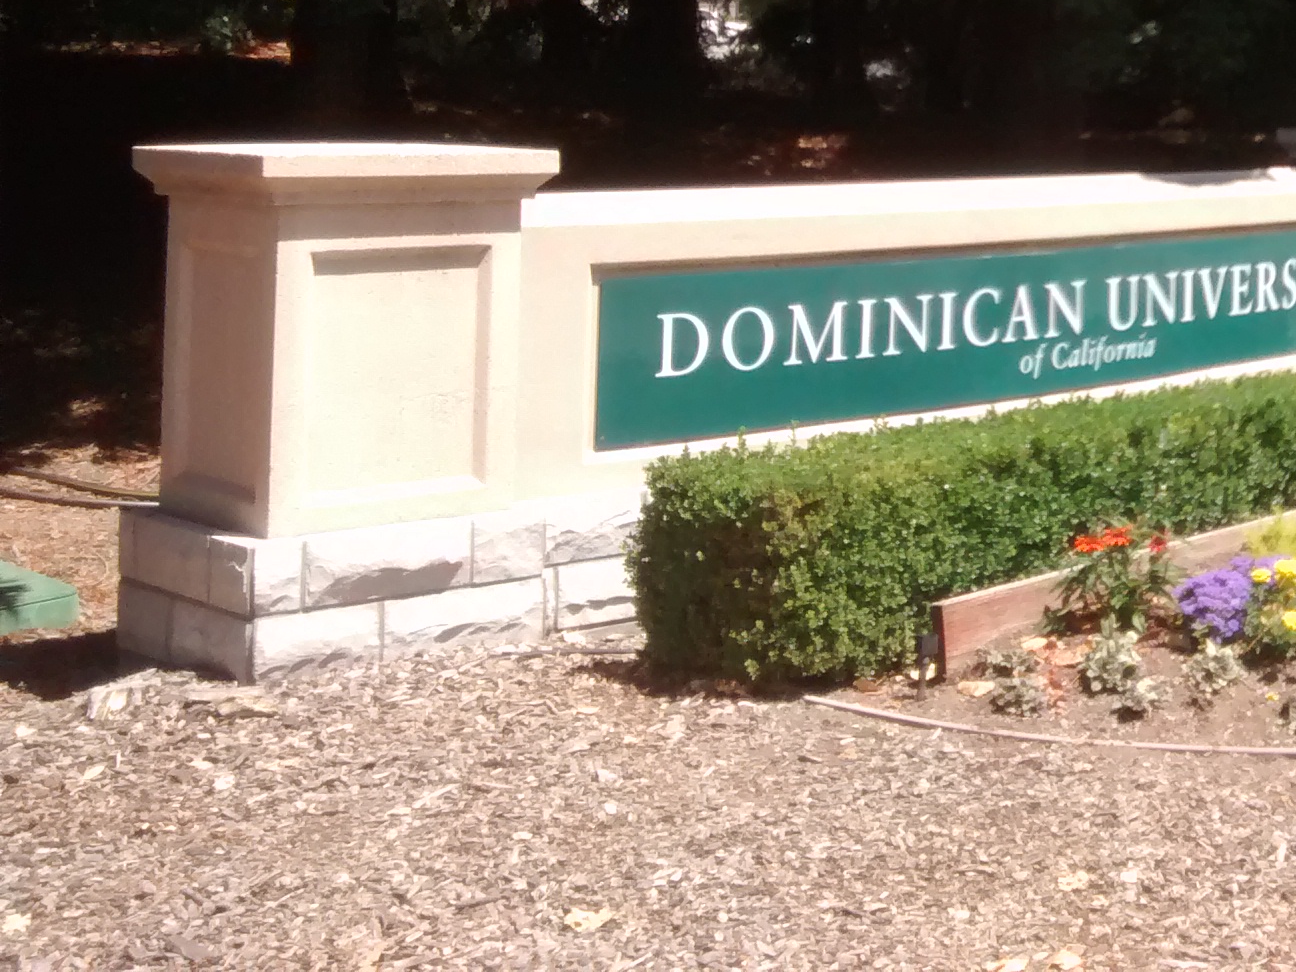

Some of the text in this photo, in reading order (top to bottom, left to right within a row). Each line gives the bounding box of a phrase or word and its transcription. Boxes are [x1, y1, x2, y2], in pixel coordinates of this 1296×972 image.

[654, 280, 1086, 378] DOMINICAN
[1019, 332, 1157, 378] of California
